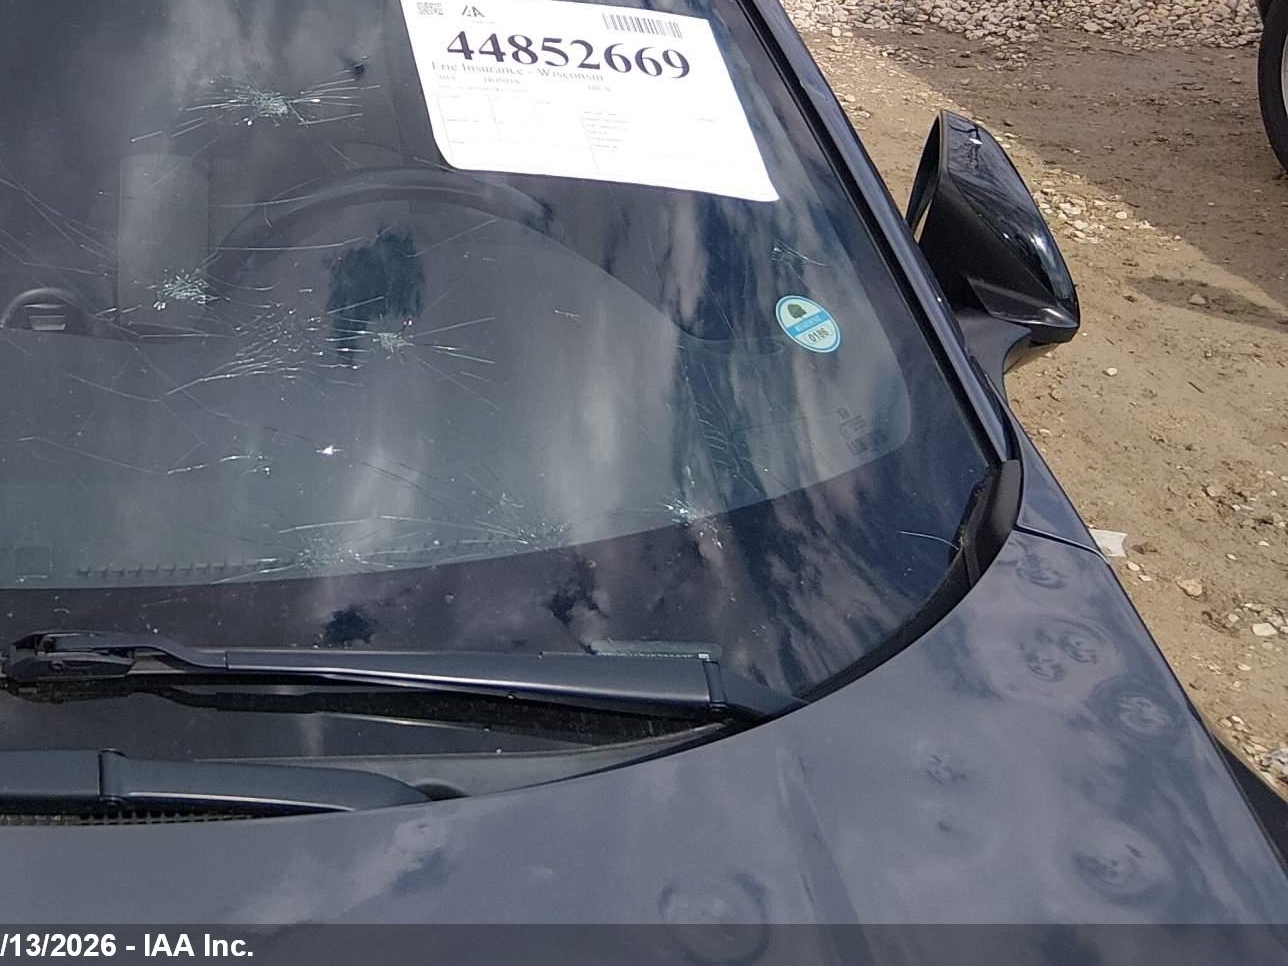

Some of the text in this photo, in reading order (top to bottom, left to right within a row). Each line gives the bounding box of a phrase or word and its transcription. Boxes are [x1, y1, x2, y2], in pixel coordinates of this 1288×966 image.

[447, 30, 690, 79] 44852669
[462, 62, 524, 75] Insurance
[537, 67, 604, 82] Wisconsin
